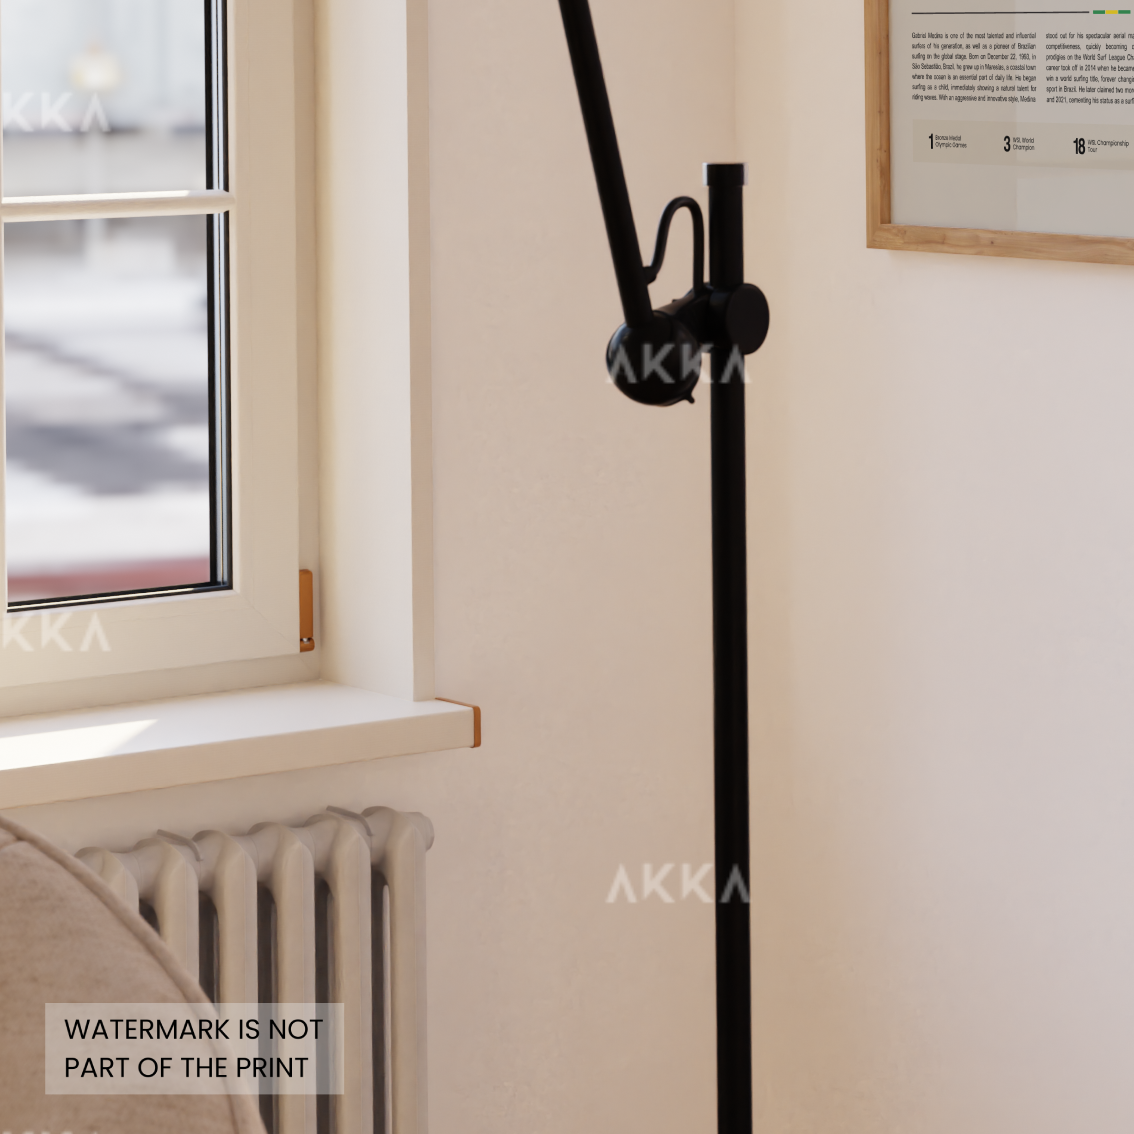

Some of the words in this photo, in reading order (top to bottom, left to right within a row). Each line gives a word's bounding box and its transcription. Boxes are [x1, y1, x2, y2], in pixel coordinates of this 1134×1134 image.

[929, 133, 933, 149] 1
[1004, 135, 1011, 152] 3
[1073, 138, 1086, 154] 18
